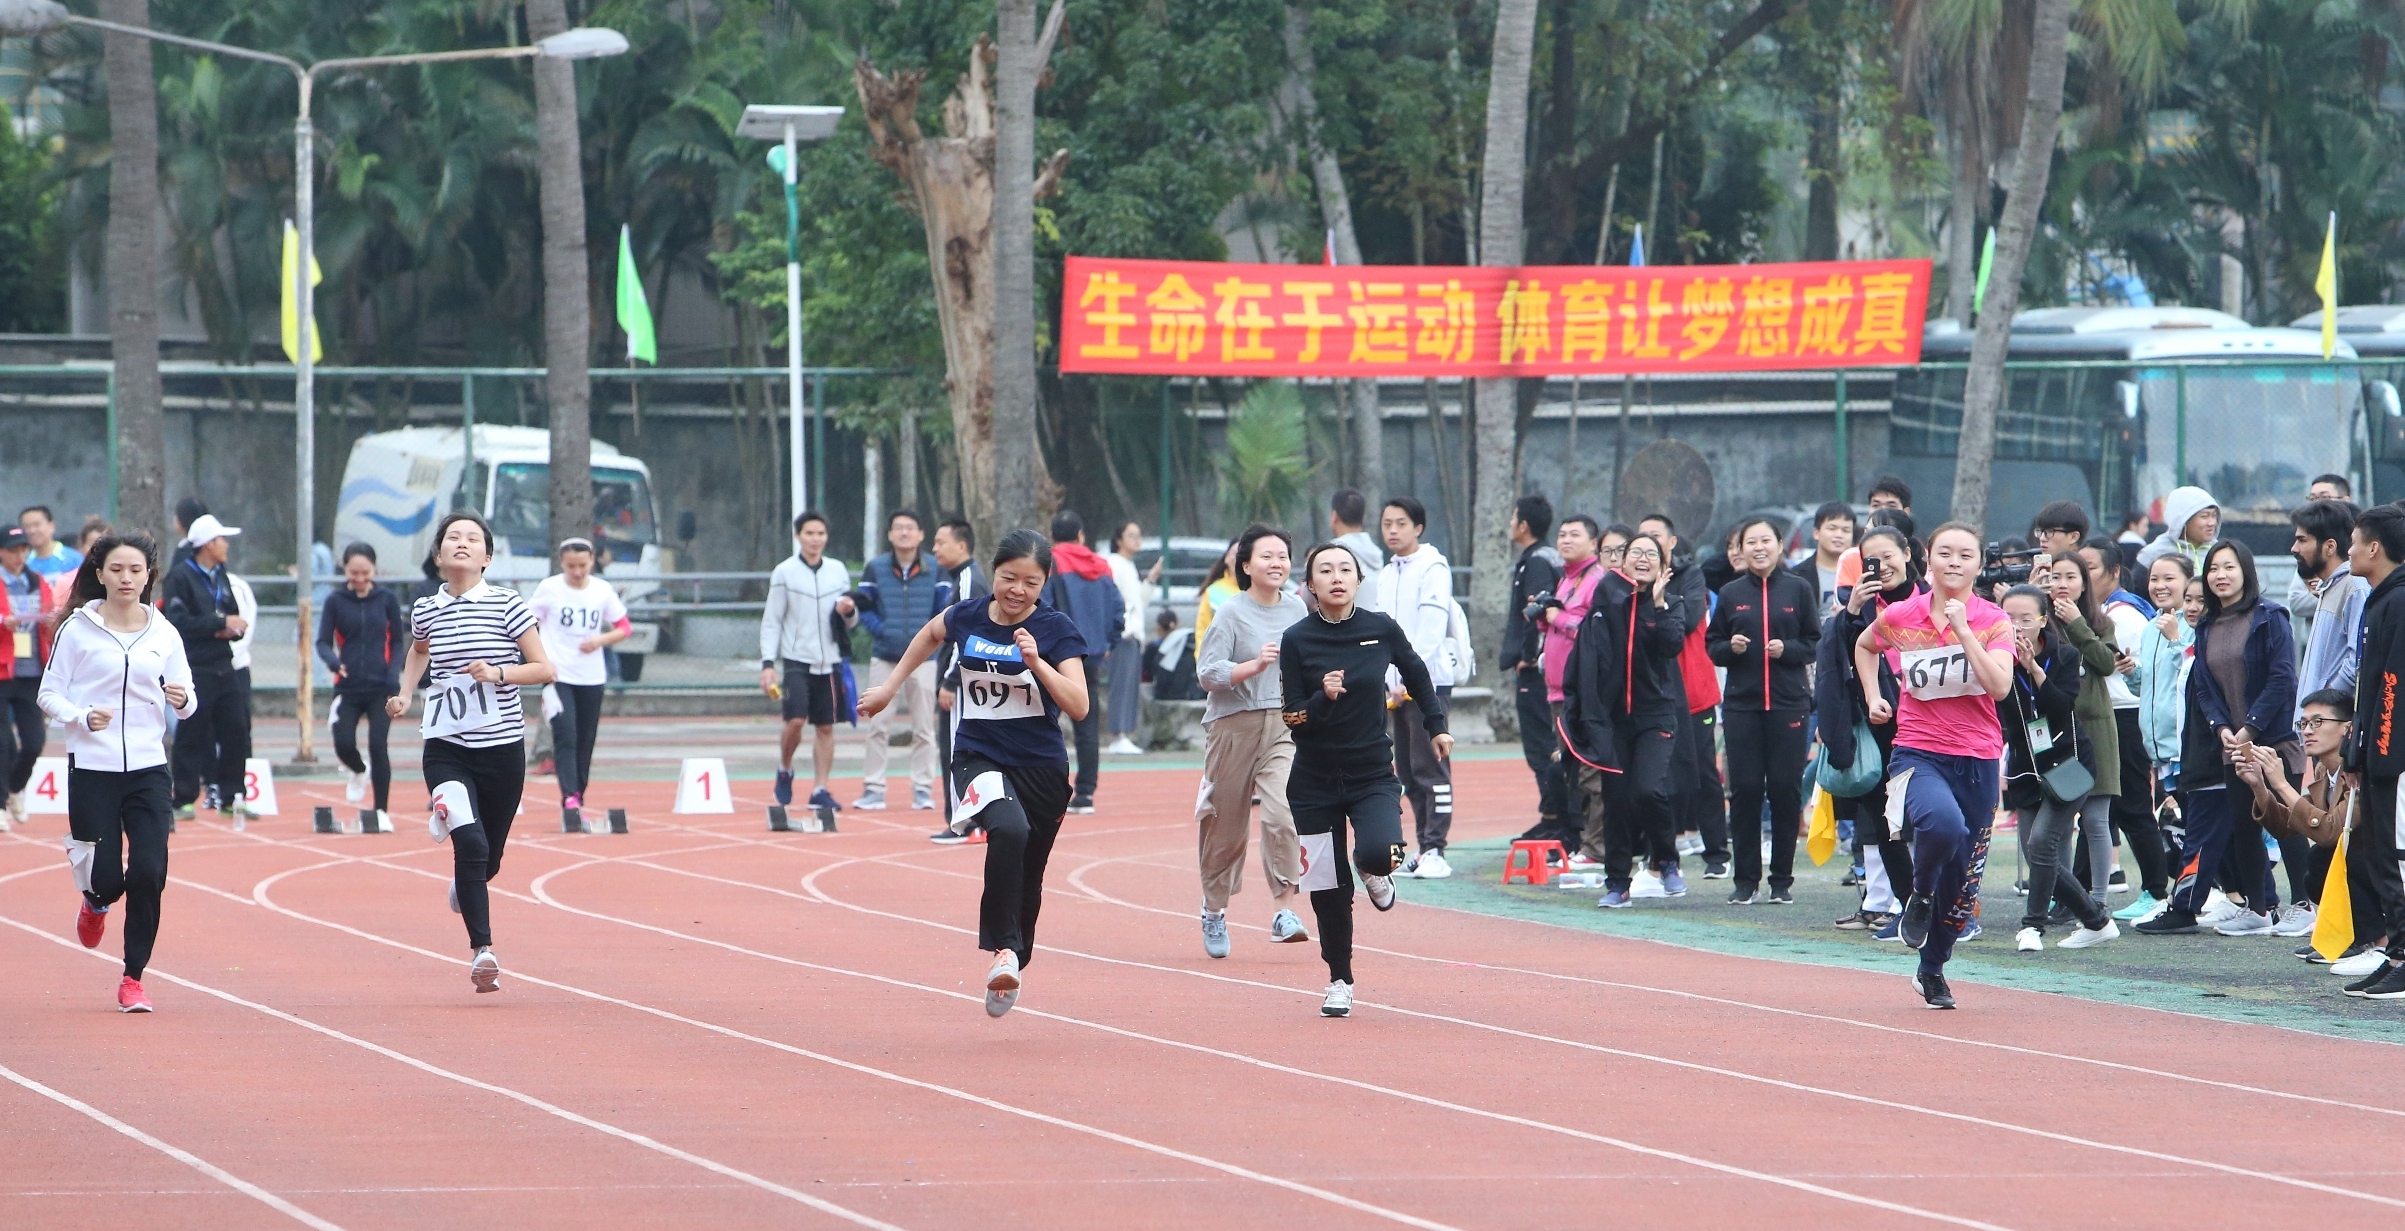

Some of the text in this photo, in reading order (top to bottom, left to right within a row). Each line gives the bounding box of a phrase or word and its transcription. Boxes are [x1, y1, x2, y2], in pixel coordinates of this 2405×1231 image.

[1079, 271, 1914, 364] 生命在于运动 体育让梦想成真
[560, 606, 600, 630] 819
[974, 640, 1015, 656] WORK
[1908, 652, 1969, 688] 677
[428, 681, 489, 728] 701
[36, 771, 58, 800] 4
[696, 771, 711, 800] 1
